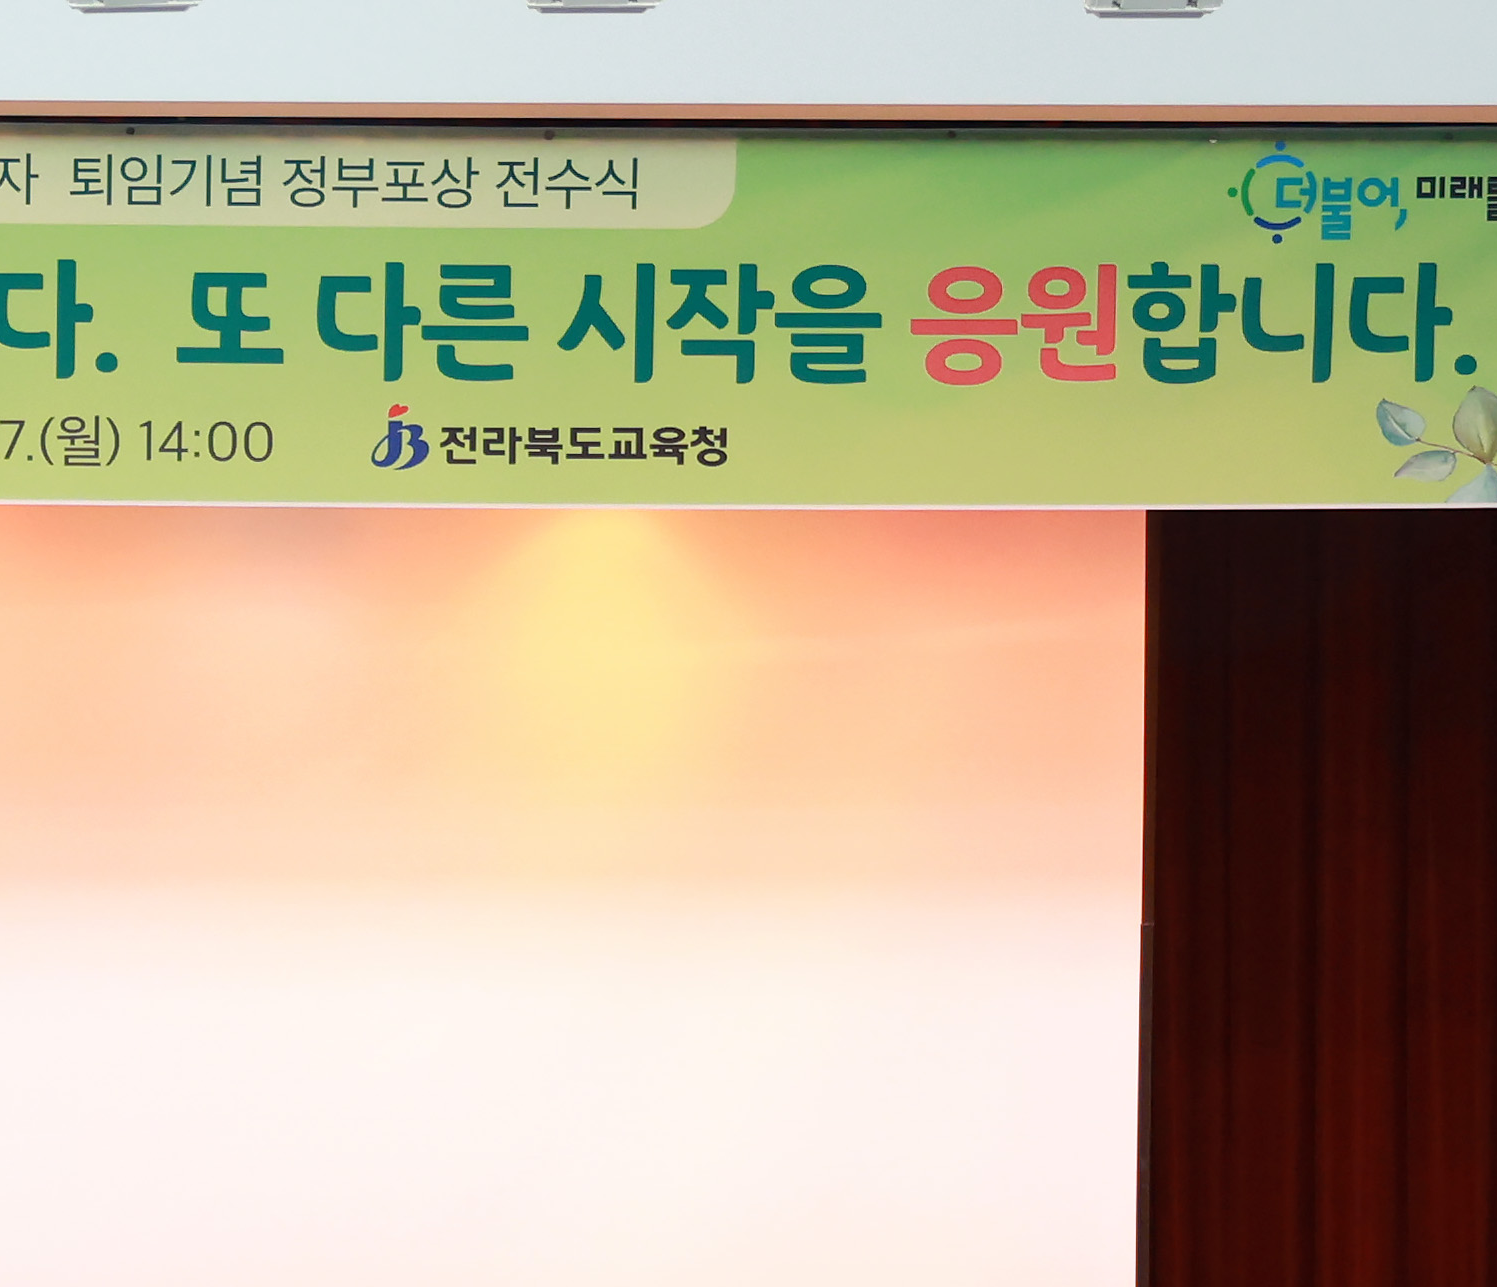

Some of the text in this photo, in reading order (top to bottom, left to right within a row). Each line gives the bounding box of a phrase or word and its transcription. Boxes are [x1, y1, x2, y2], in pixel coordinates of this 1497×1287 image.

[69, 153, 263, 208] 퇴임기념
[283, 155, 480, 209] 정부포상
[494, 157, 640, 211] 전수식
[176, 271, 284, 364] 또
[316, 261, 529, 383] 다른
[557, 262, 883, 385] 시작을
[910, 261, 1479, 386] 응원합니다.
[139, 420, 274, 463] 14:00
[439, 425, 729, 468] 전라북도교육청
